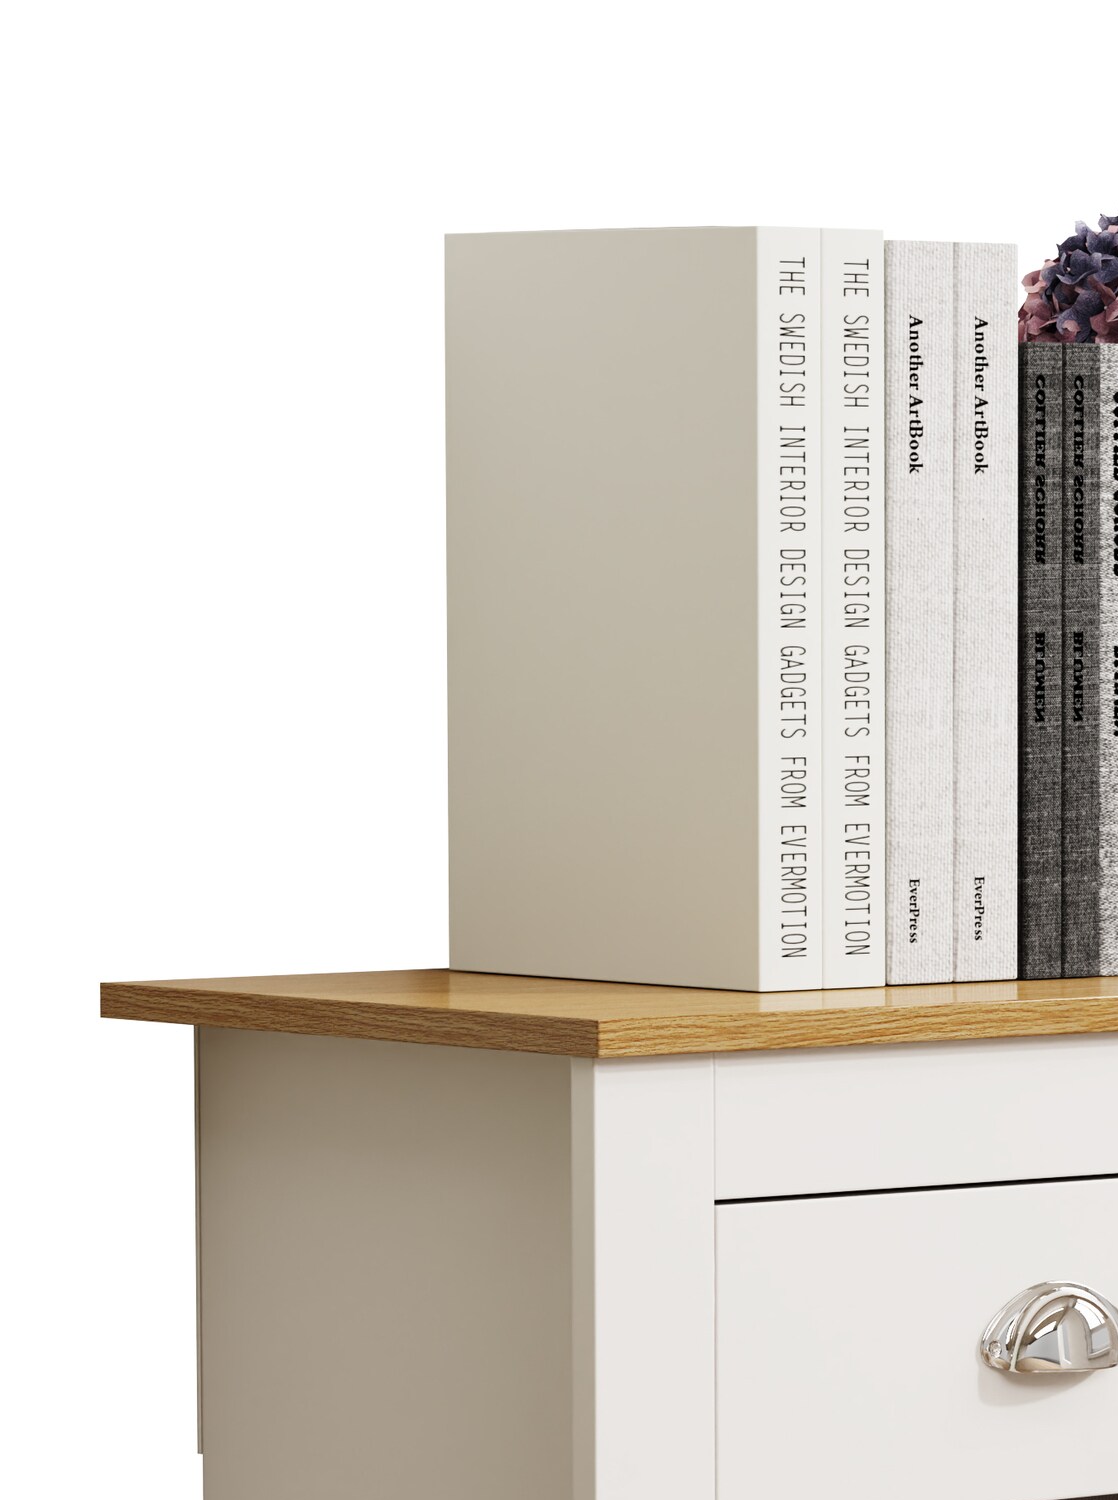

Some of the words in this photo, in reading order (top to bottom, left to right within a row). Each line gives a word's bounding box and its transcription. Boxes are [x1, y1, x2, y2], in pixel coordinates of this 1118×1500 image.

[778, 256, 806, 296] THE
[843, 258, 870, 298] THE
[779, 313, 806, 407] SWEDISH
[843, 314, 870, 408] SWEDISH
[909, 314, 924, 391] Another
[974, 316, 989, 392] Another
[909, 394, 924, 474] ArtBook
[974, 395, 989, 475] ArtBook
[779, 425, 807, 533] INTERIOR
[843, 426, 870, 533] INTERIOR
[779, 549, 807, 629] DESIGN
[843, 549, 870, 628] DESIGN
[780, 645, 807, 739] GADGETS
[844, 644, 871, 738] GADGETS
[780, 756, 807, 809] FROM
[844, 755, 871, 807] FROM
[780, 825, 808, 958] EVERMOTION
[844, 823, 871, 956] EVERMOTION
[909, 879, 920, 944] EverPress
[974, 876, 985, 941] EverPress
